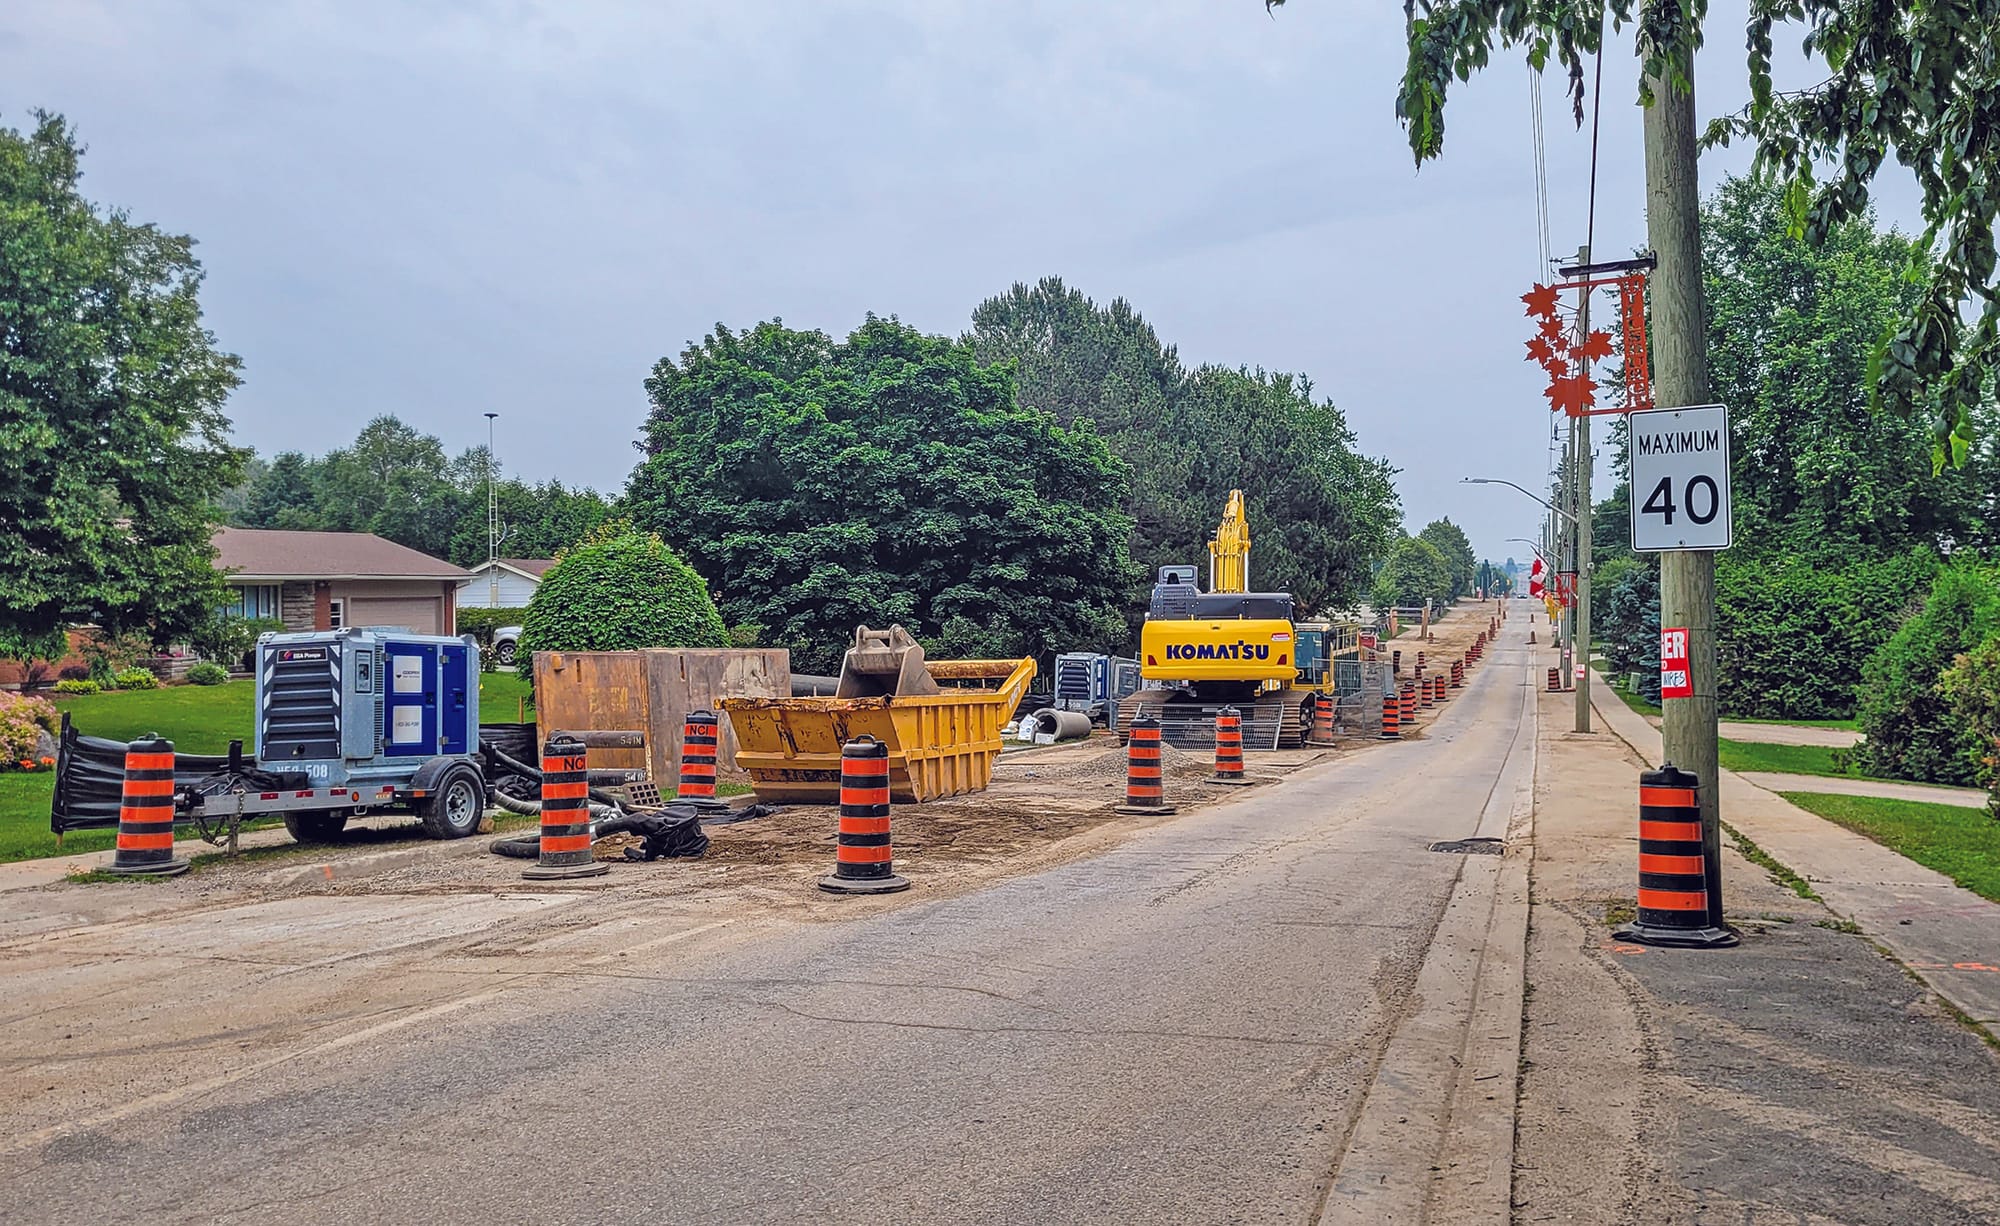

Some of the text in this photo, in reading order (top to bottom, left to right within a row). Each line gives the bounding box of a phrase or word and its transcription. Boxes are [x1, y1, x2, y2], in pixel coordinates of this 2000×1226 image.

[1639, 429, 1719, 456] MAXIMUM
[1641, 474, 1719, 526] 40
[1166, 640, 1269, 660] KOMATSU
[1661, 631, 1685, 659] ER
[689, 725, 709, 736] NCI
